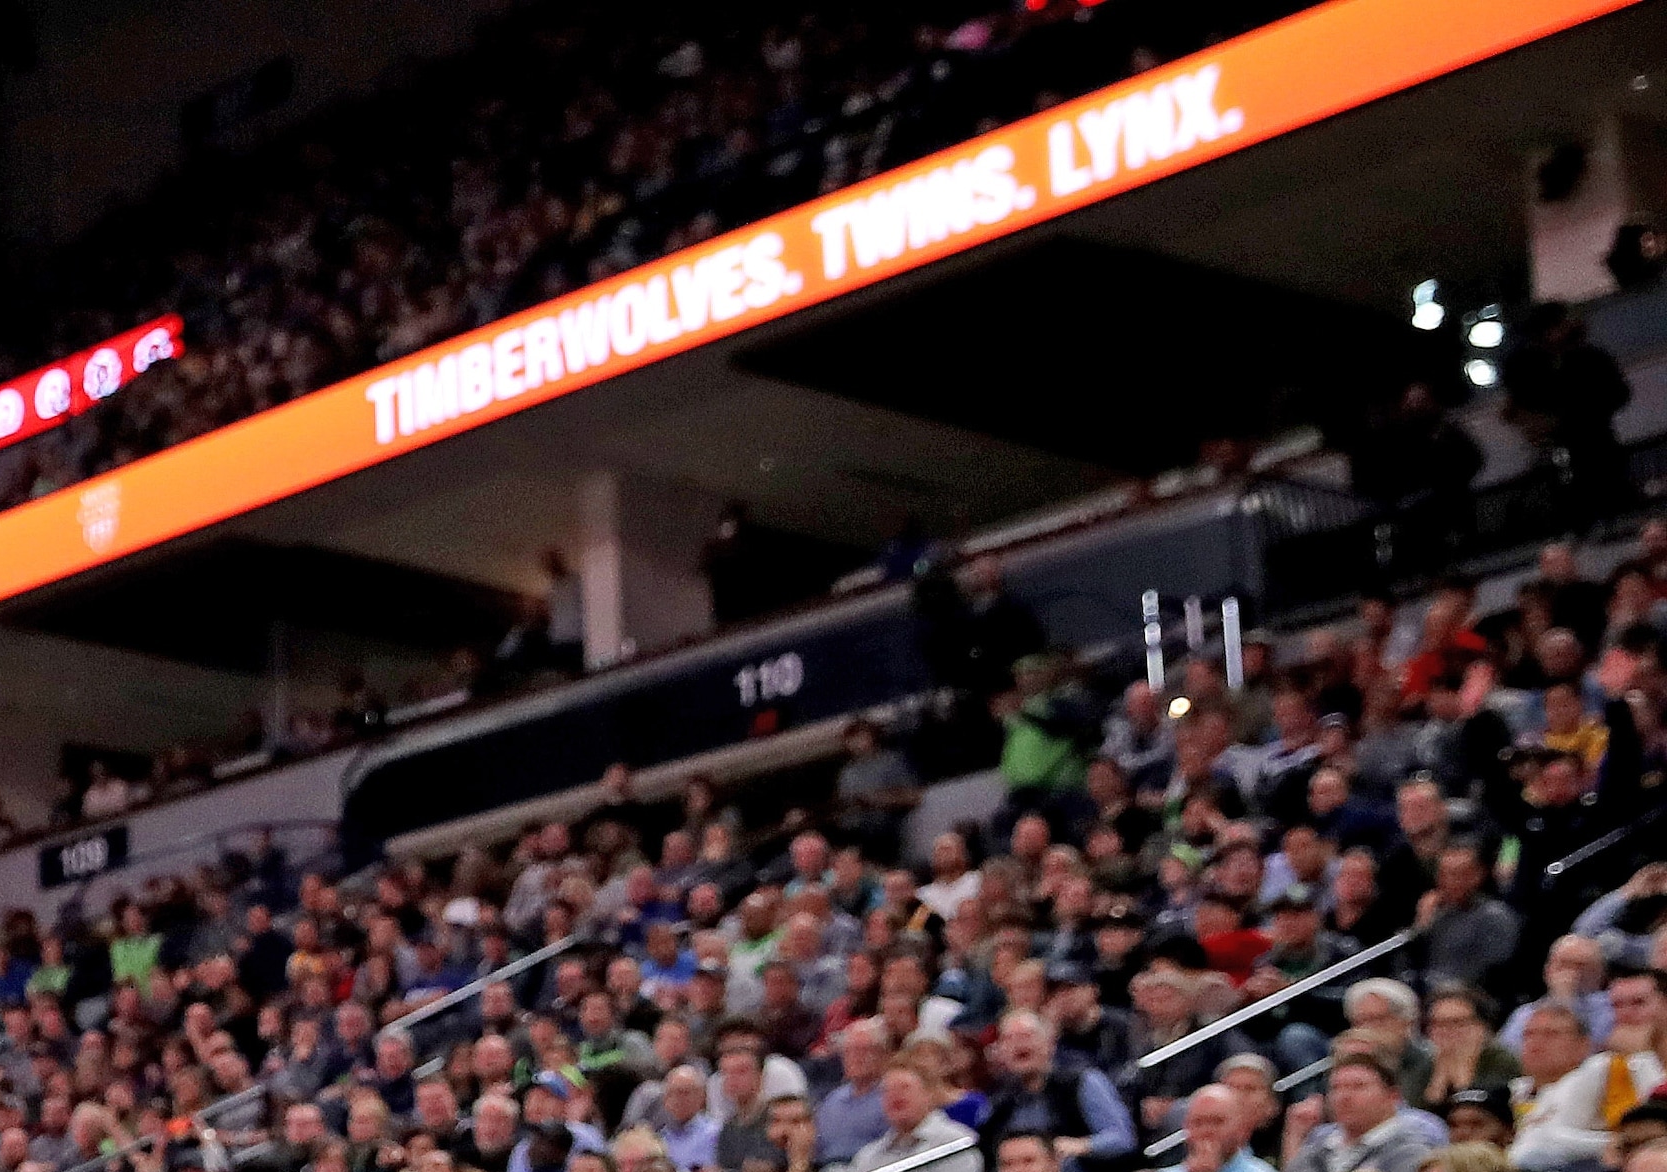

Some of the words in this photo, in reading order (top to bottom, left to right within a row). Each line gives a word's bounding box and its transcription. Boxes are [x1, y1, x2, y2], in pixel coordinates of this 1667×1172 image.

[366, 233, 803, 444] TIMBERWOLVES.
[811, 145, 1036, 279] TWINS.
[1048, 65, 1244, 196] LYNX.
